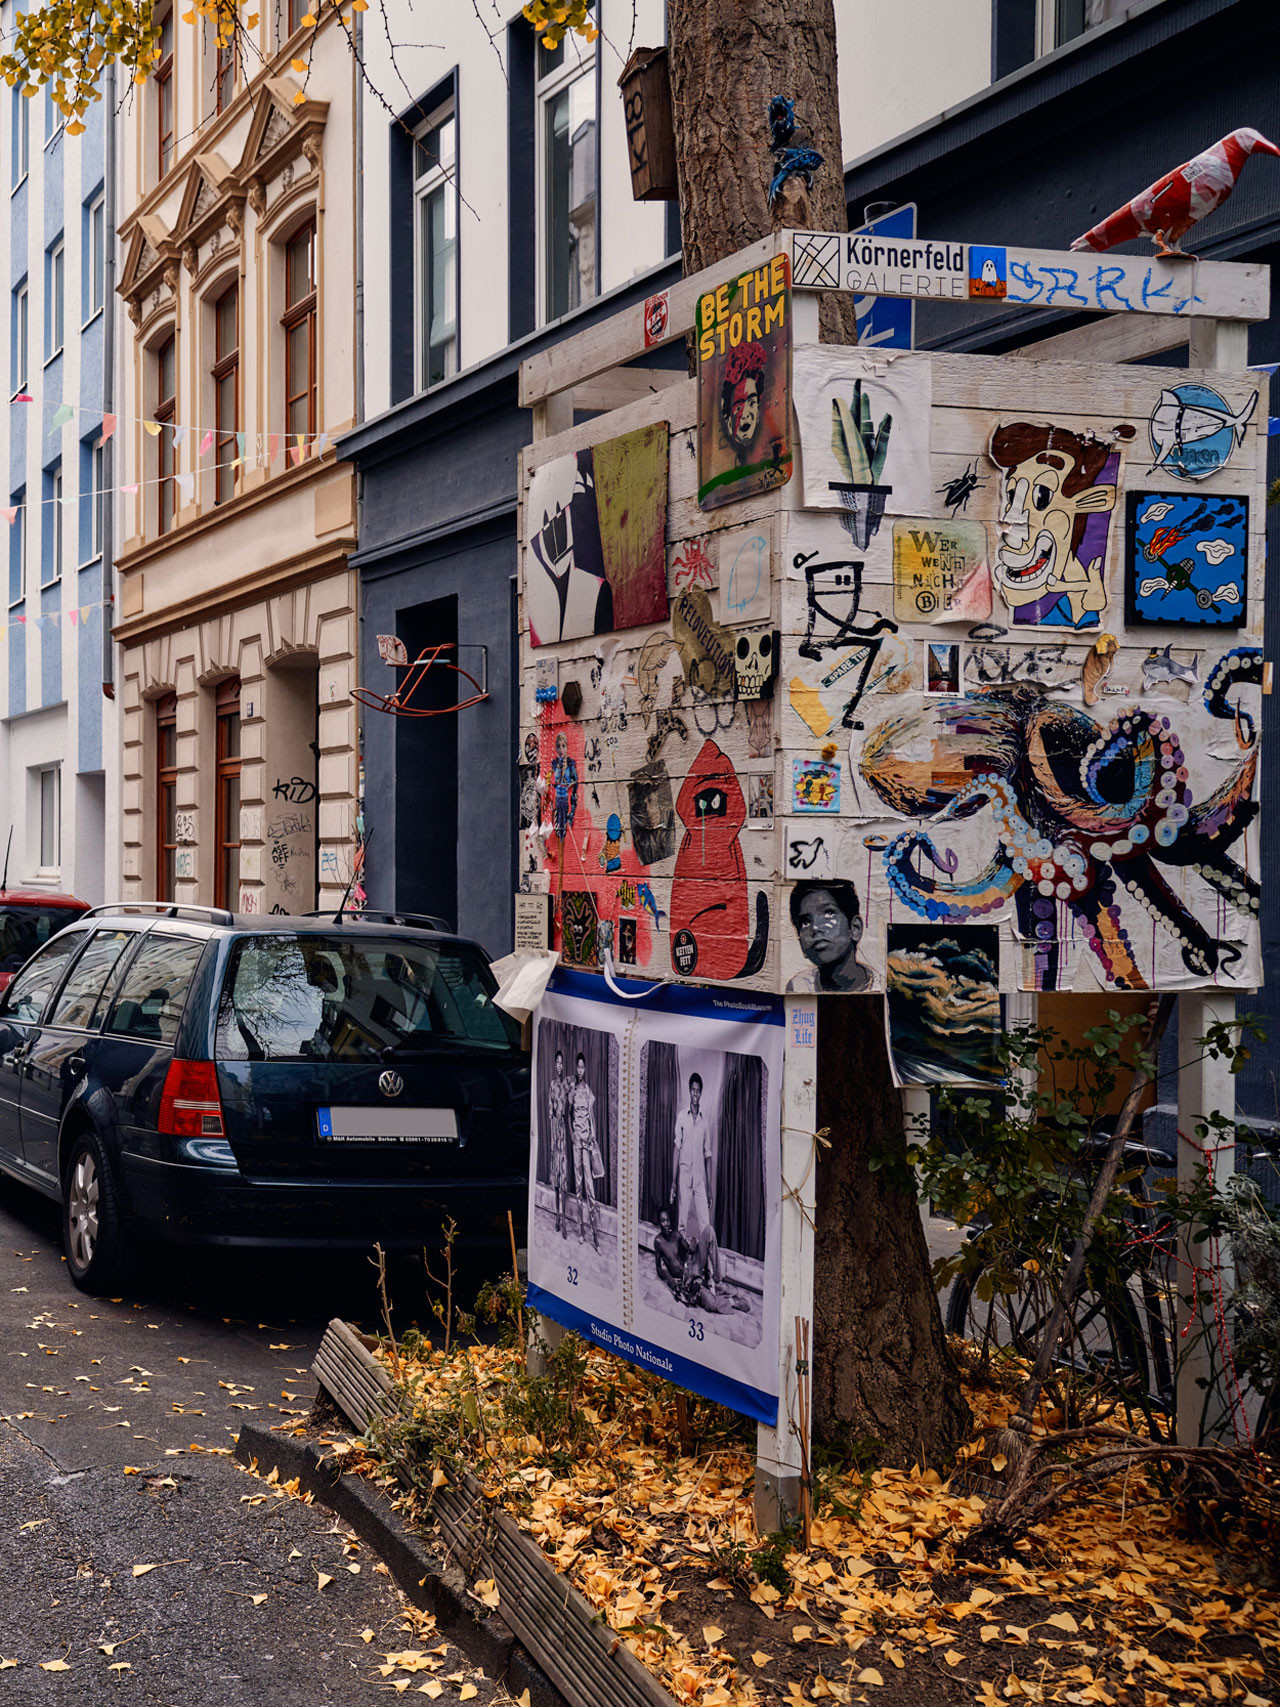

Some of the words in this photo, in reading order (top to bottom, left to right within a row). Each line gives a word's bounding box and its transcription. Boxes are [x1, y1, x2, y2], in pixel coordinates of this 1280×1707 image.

[847, 237, 964, 272] Körnerfeld
[701, 283, 730, 331] BE
[738, 254, 785, 310] THE
[847, 270, 964, 298] GALERIE
[699, 295, 785, 362] STORM
[908, 530, 958, 553] WER
[794, 1028, 813, 1044] Life
[323, 1124, 329, 1132] D
[566, 1265, 579, 1286] 32
[688, 1318, 705, 1342] 33
[590, 1323, 613, 1344] Studio
[613, 1333, 635, 1355] Photo
[635, 1344, 673, 1372] Nationale
